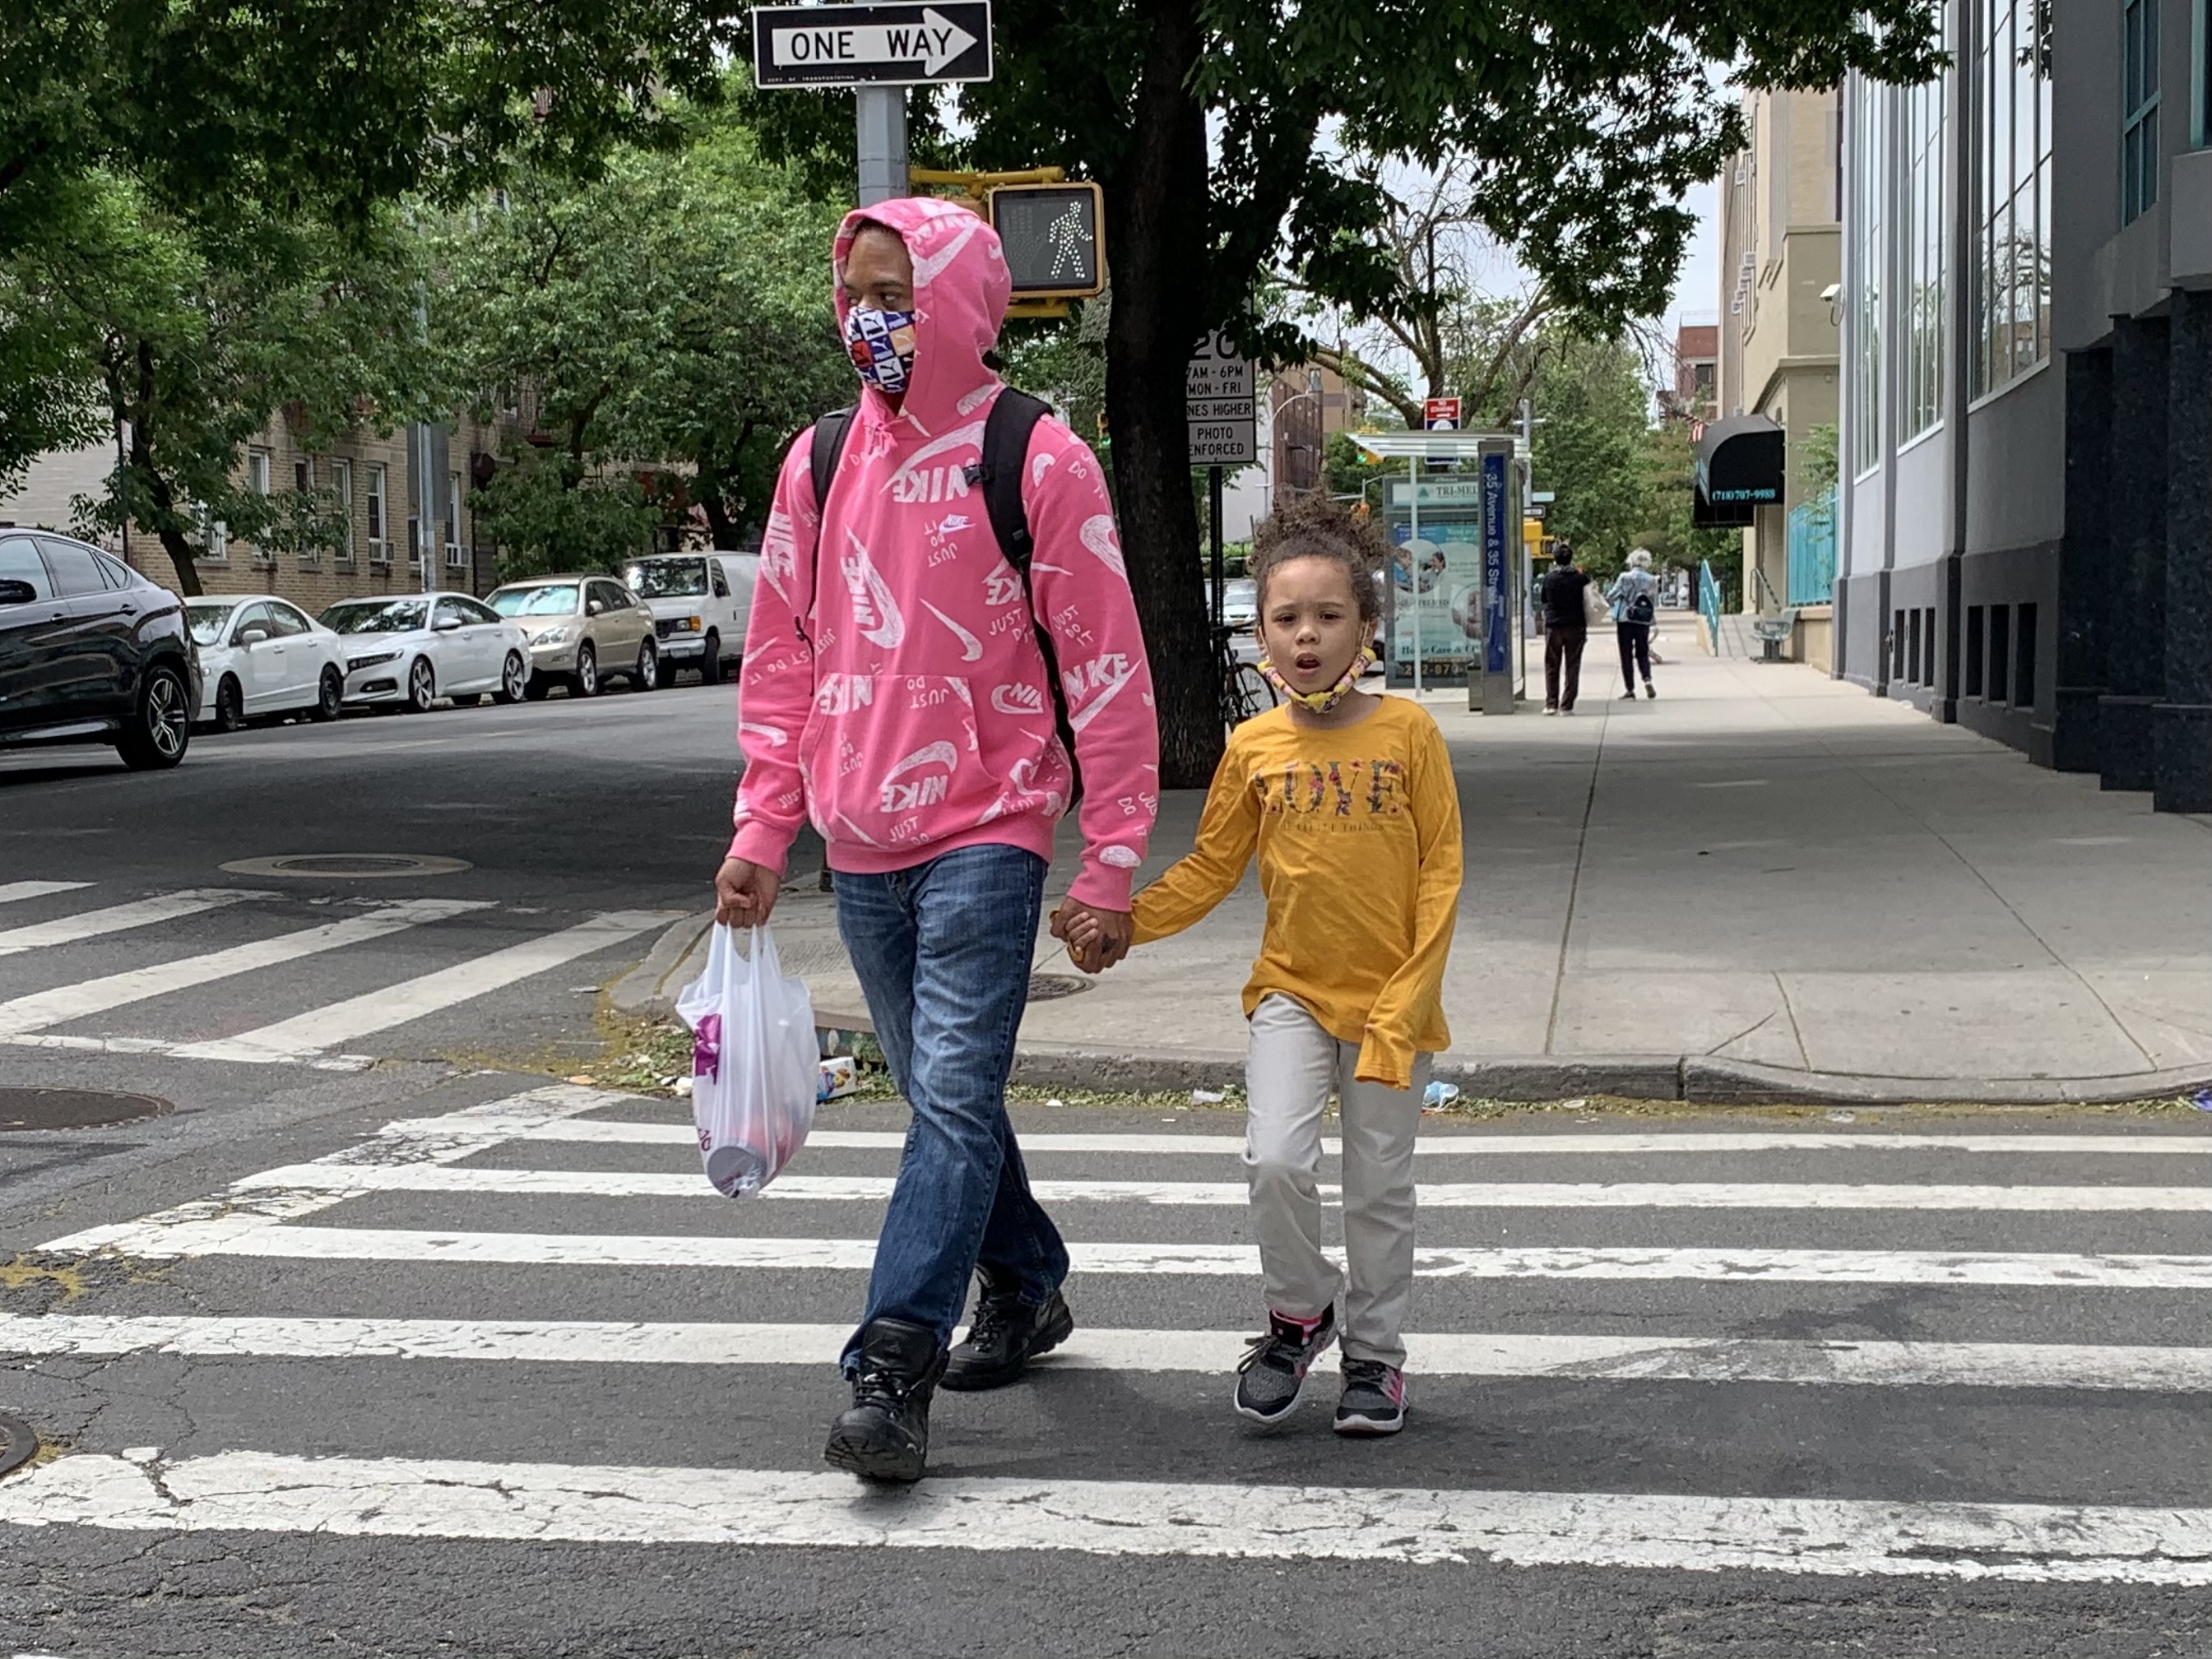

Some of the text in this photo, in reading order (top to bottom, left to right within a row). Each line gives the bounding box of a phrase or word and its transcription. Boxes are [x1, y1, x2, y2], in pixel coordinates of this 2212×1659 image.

[791, 27, 953, 61] ONE WAY
[1219, 365, 1243, 378] 6PM
[1188, 382, 1212, 396] MON
[1222, 382, 1241, 394] FRI
[1187, 402, 1251, 416] NES HIGHER
[1197, 426, 1233, 440] PHOTO
[1188, 443, 1244, 456] ENFORCED
[1068, 461, 1087, 480] DO
[944, 513, 970, 526] NIKE
[1486, 491, 1498, 535] Avenue
[923, 520, 937, 535] IT
[930, 532, 945, 547] DO
[928, 542, 958, 568] JUST
[1487, 551, 1499, 566] 35
[840, 557, 875, 627] NIKE
[984, 573, 1027, 606] KE
[989, 608, 1023, 636] JUST
[1052, 604, 1079, 631] JUST
[1065, 623, 1081, 638] DO
[1076, 630, 1094, 646] IT
[1402, 646, 1429, 655] Hoe
[767, 659, 787, 673] DO
[749, 672, 763, 686] IT
[907, 676, 925, 691] DO
[910, 689, 949, 709] JUST
[879, 775, 948, 813] NIKE
[1118, 796, 1137, 816] DO
[888, 816, 919, 843] JUST
